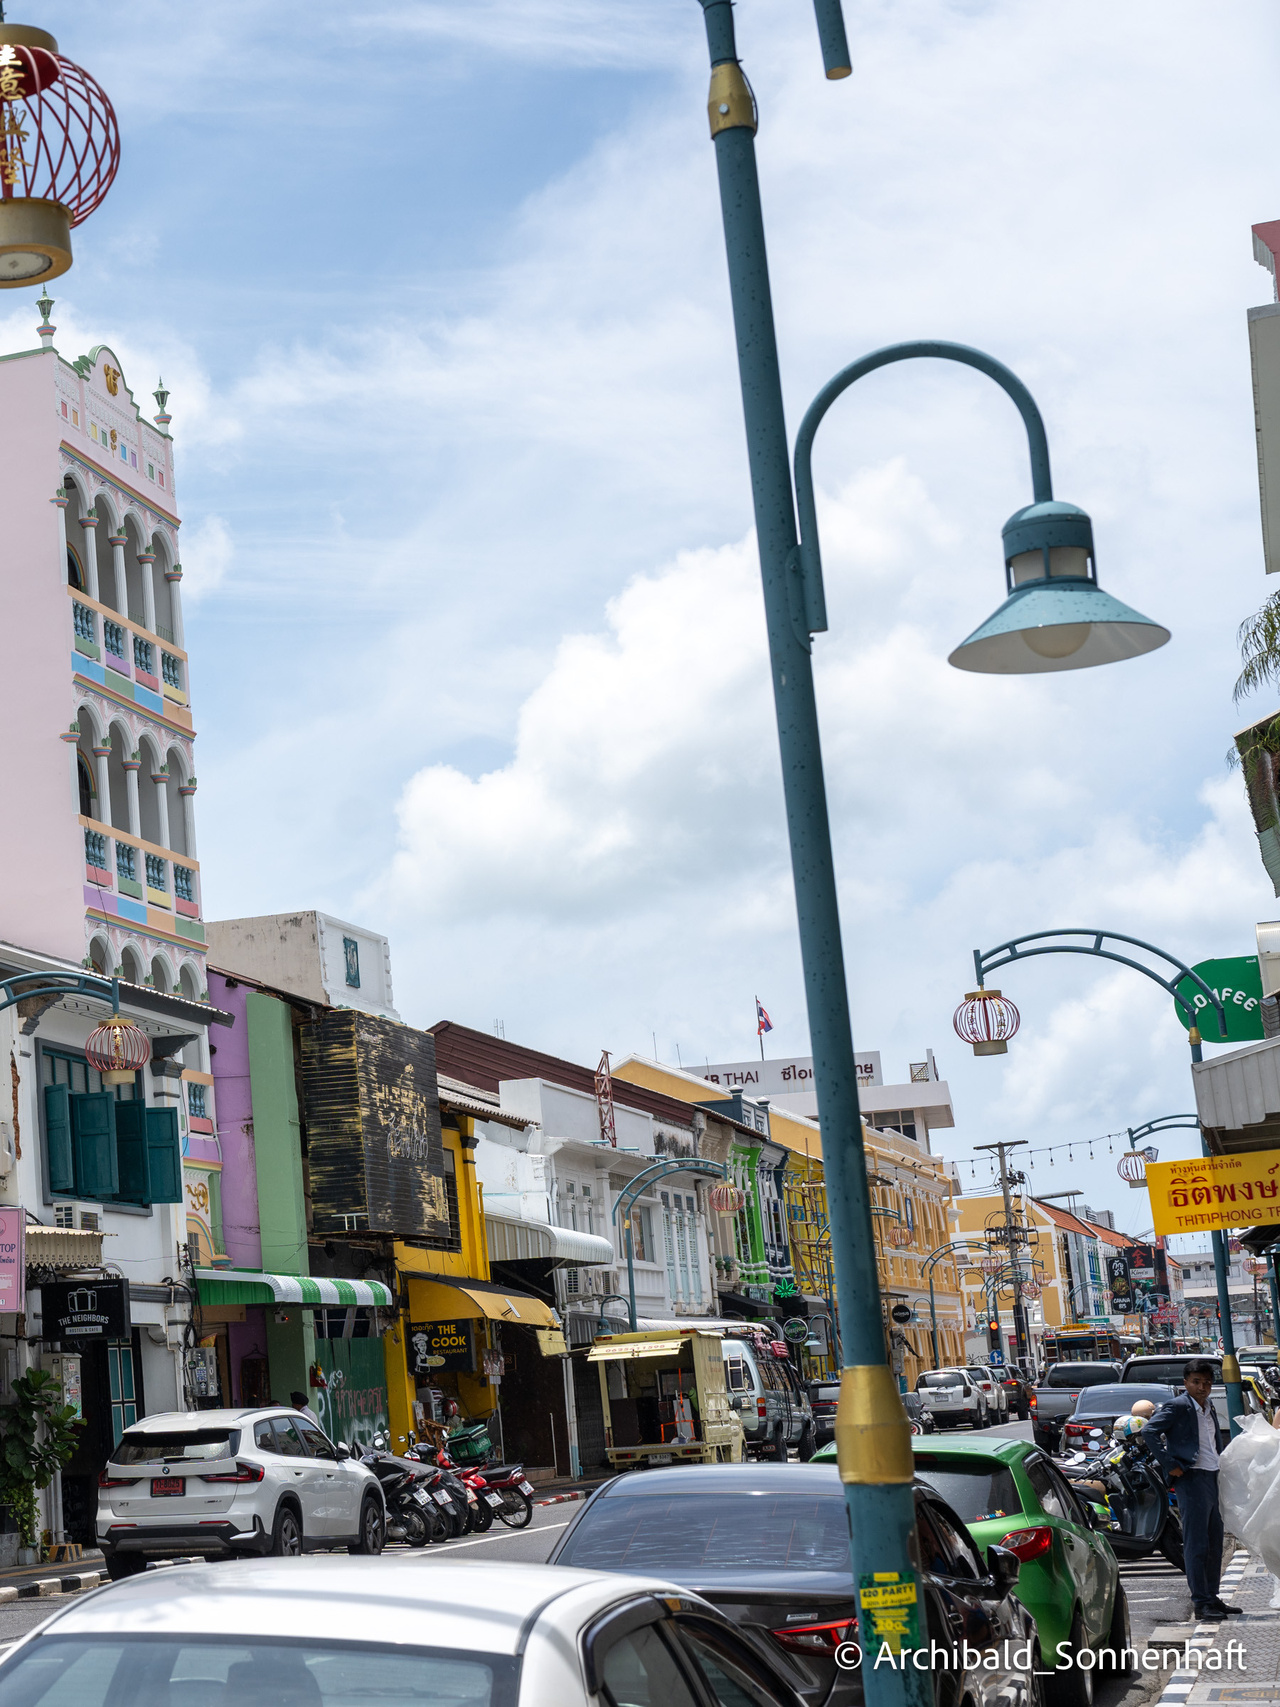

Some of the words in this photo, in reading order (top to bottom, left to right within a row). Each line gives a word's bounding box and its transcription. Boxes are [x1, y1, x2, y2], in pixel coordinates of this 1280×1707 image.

[723, 1070, 760, 1086] THAI
[1169, 1158, 1242, 1176] ห้างหุ้นส่วนจำกัด
[1175, 1208, 1263, 1227] THITIPHONG
[1131, 1248, 1148, 1267] 金
[58, 1316, 71, 1326] THE
[72, 1314, 109, 1325] NEIGHBORS
[437, 1324, 457, 1335] THE
[431, 1336, 467, 1348] COOK
[433, 1347, 468, 1355] RESTAURANT
[881, 1585, 914, 1596] PARTY
